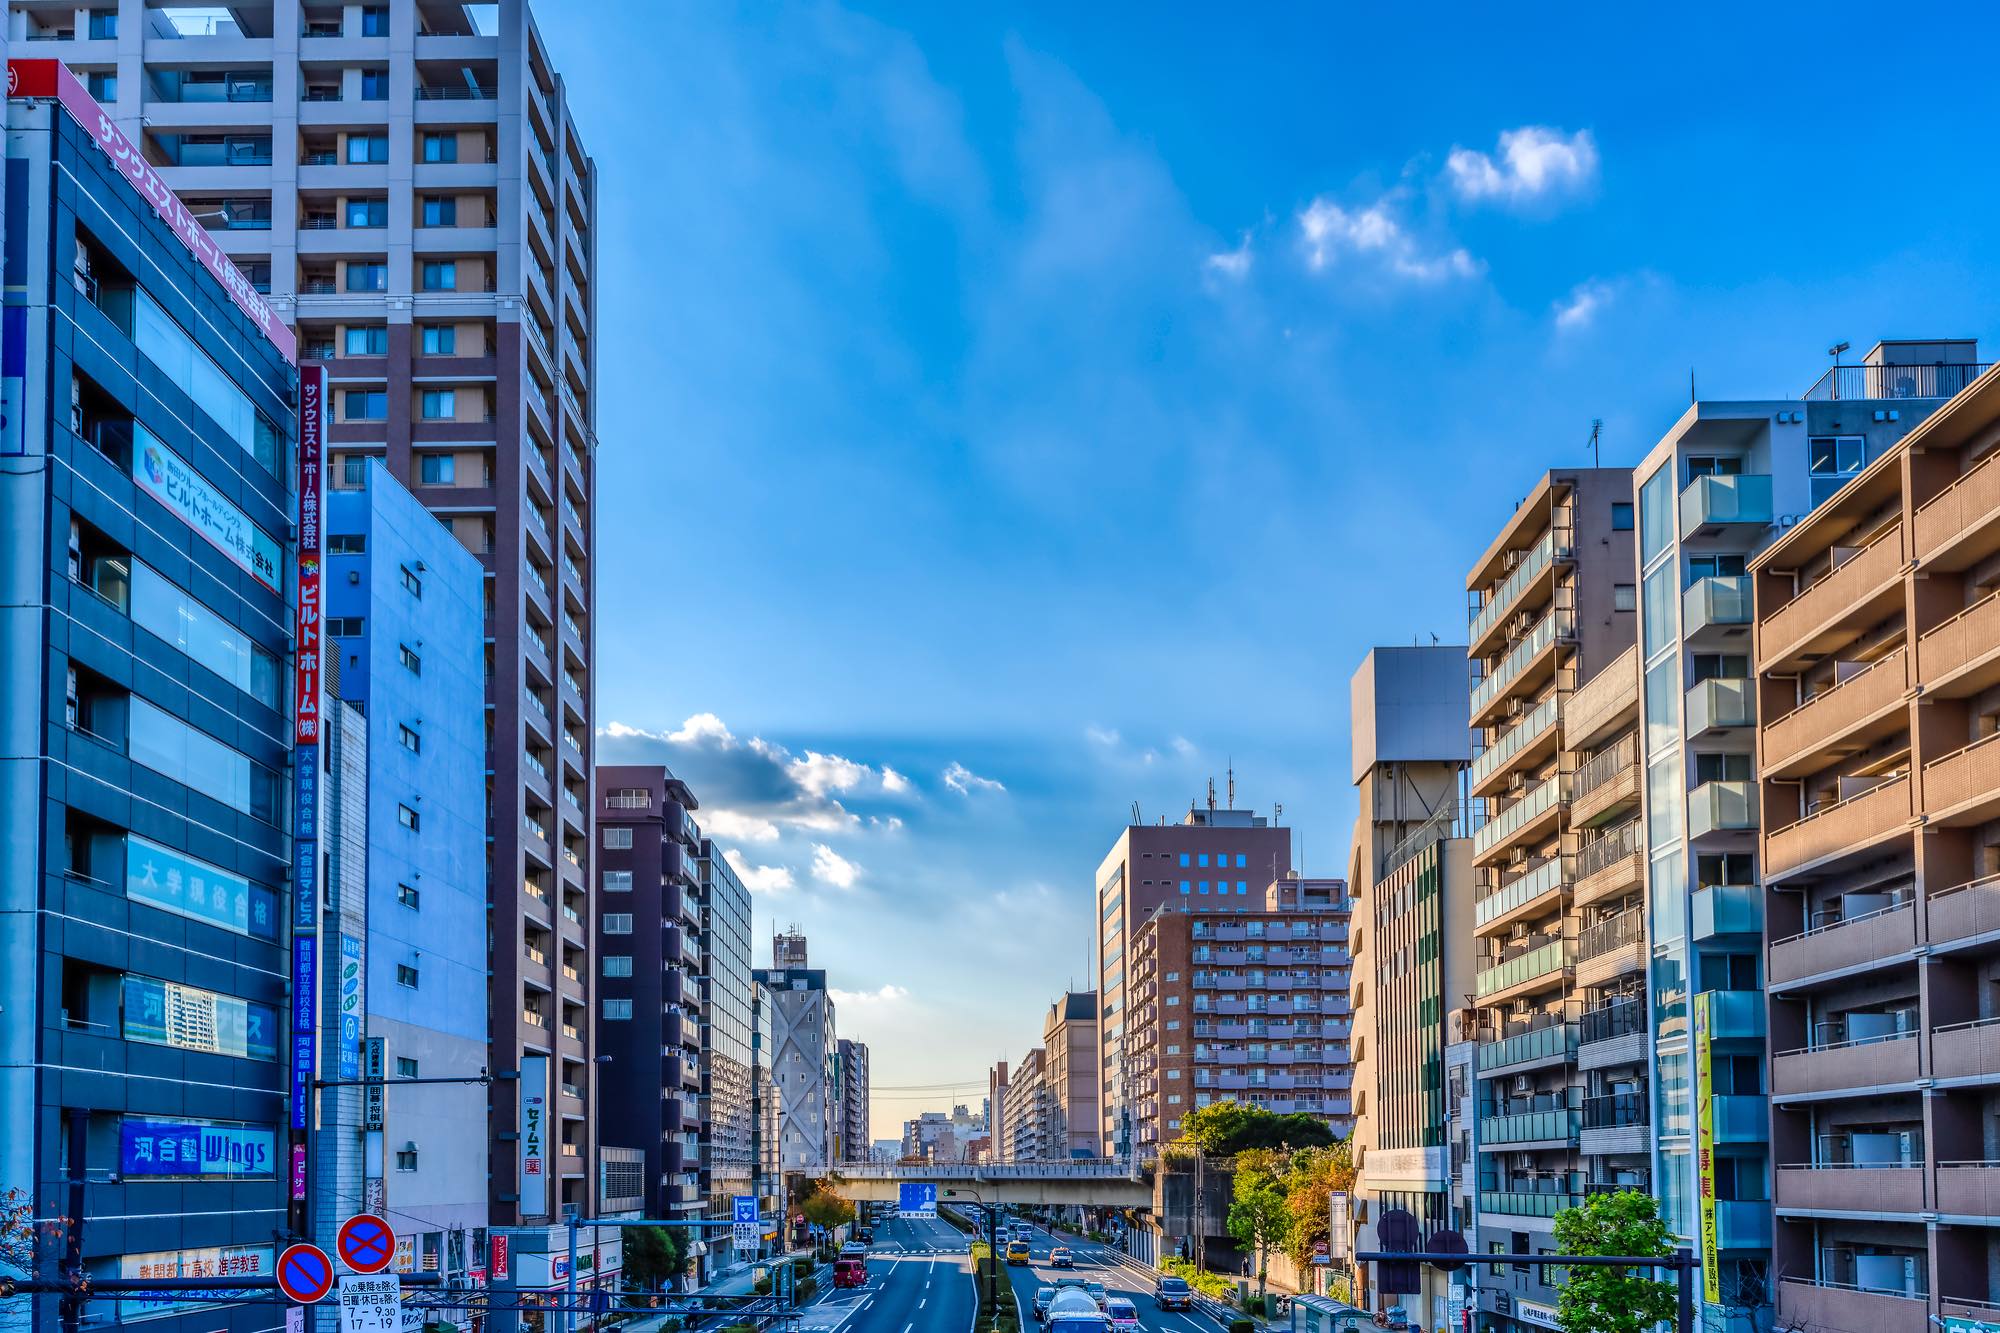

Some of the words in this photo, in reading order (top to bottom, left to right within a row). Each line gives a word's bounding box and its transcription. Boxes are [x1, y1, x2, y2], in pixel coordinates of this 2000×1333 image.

[98, 113, 272, 332] サンウエストホーム株式会社
[167, 474, 274, 580] ビルトホーム株式会社
[301, 750, 313, 834] 大学現役合格
[142, 858, 267, 926] 大学現役合格
[527, 1107, 539, 1156] セイムス
[135, 1136, 197, 1162] 河合塾
[205, 1136, 265, 1170] Wings
[218, 1254, 259, 1276] 進学教室
[342, 1281, 397, 1293] 人の乗降を除く
[348, 1307, 355, 1318] 7
[351, 1319, 363, 1330] 17
[380, 1318, 393, 1329] 19
